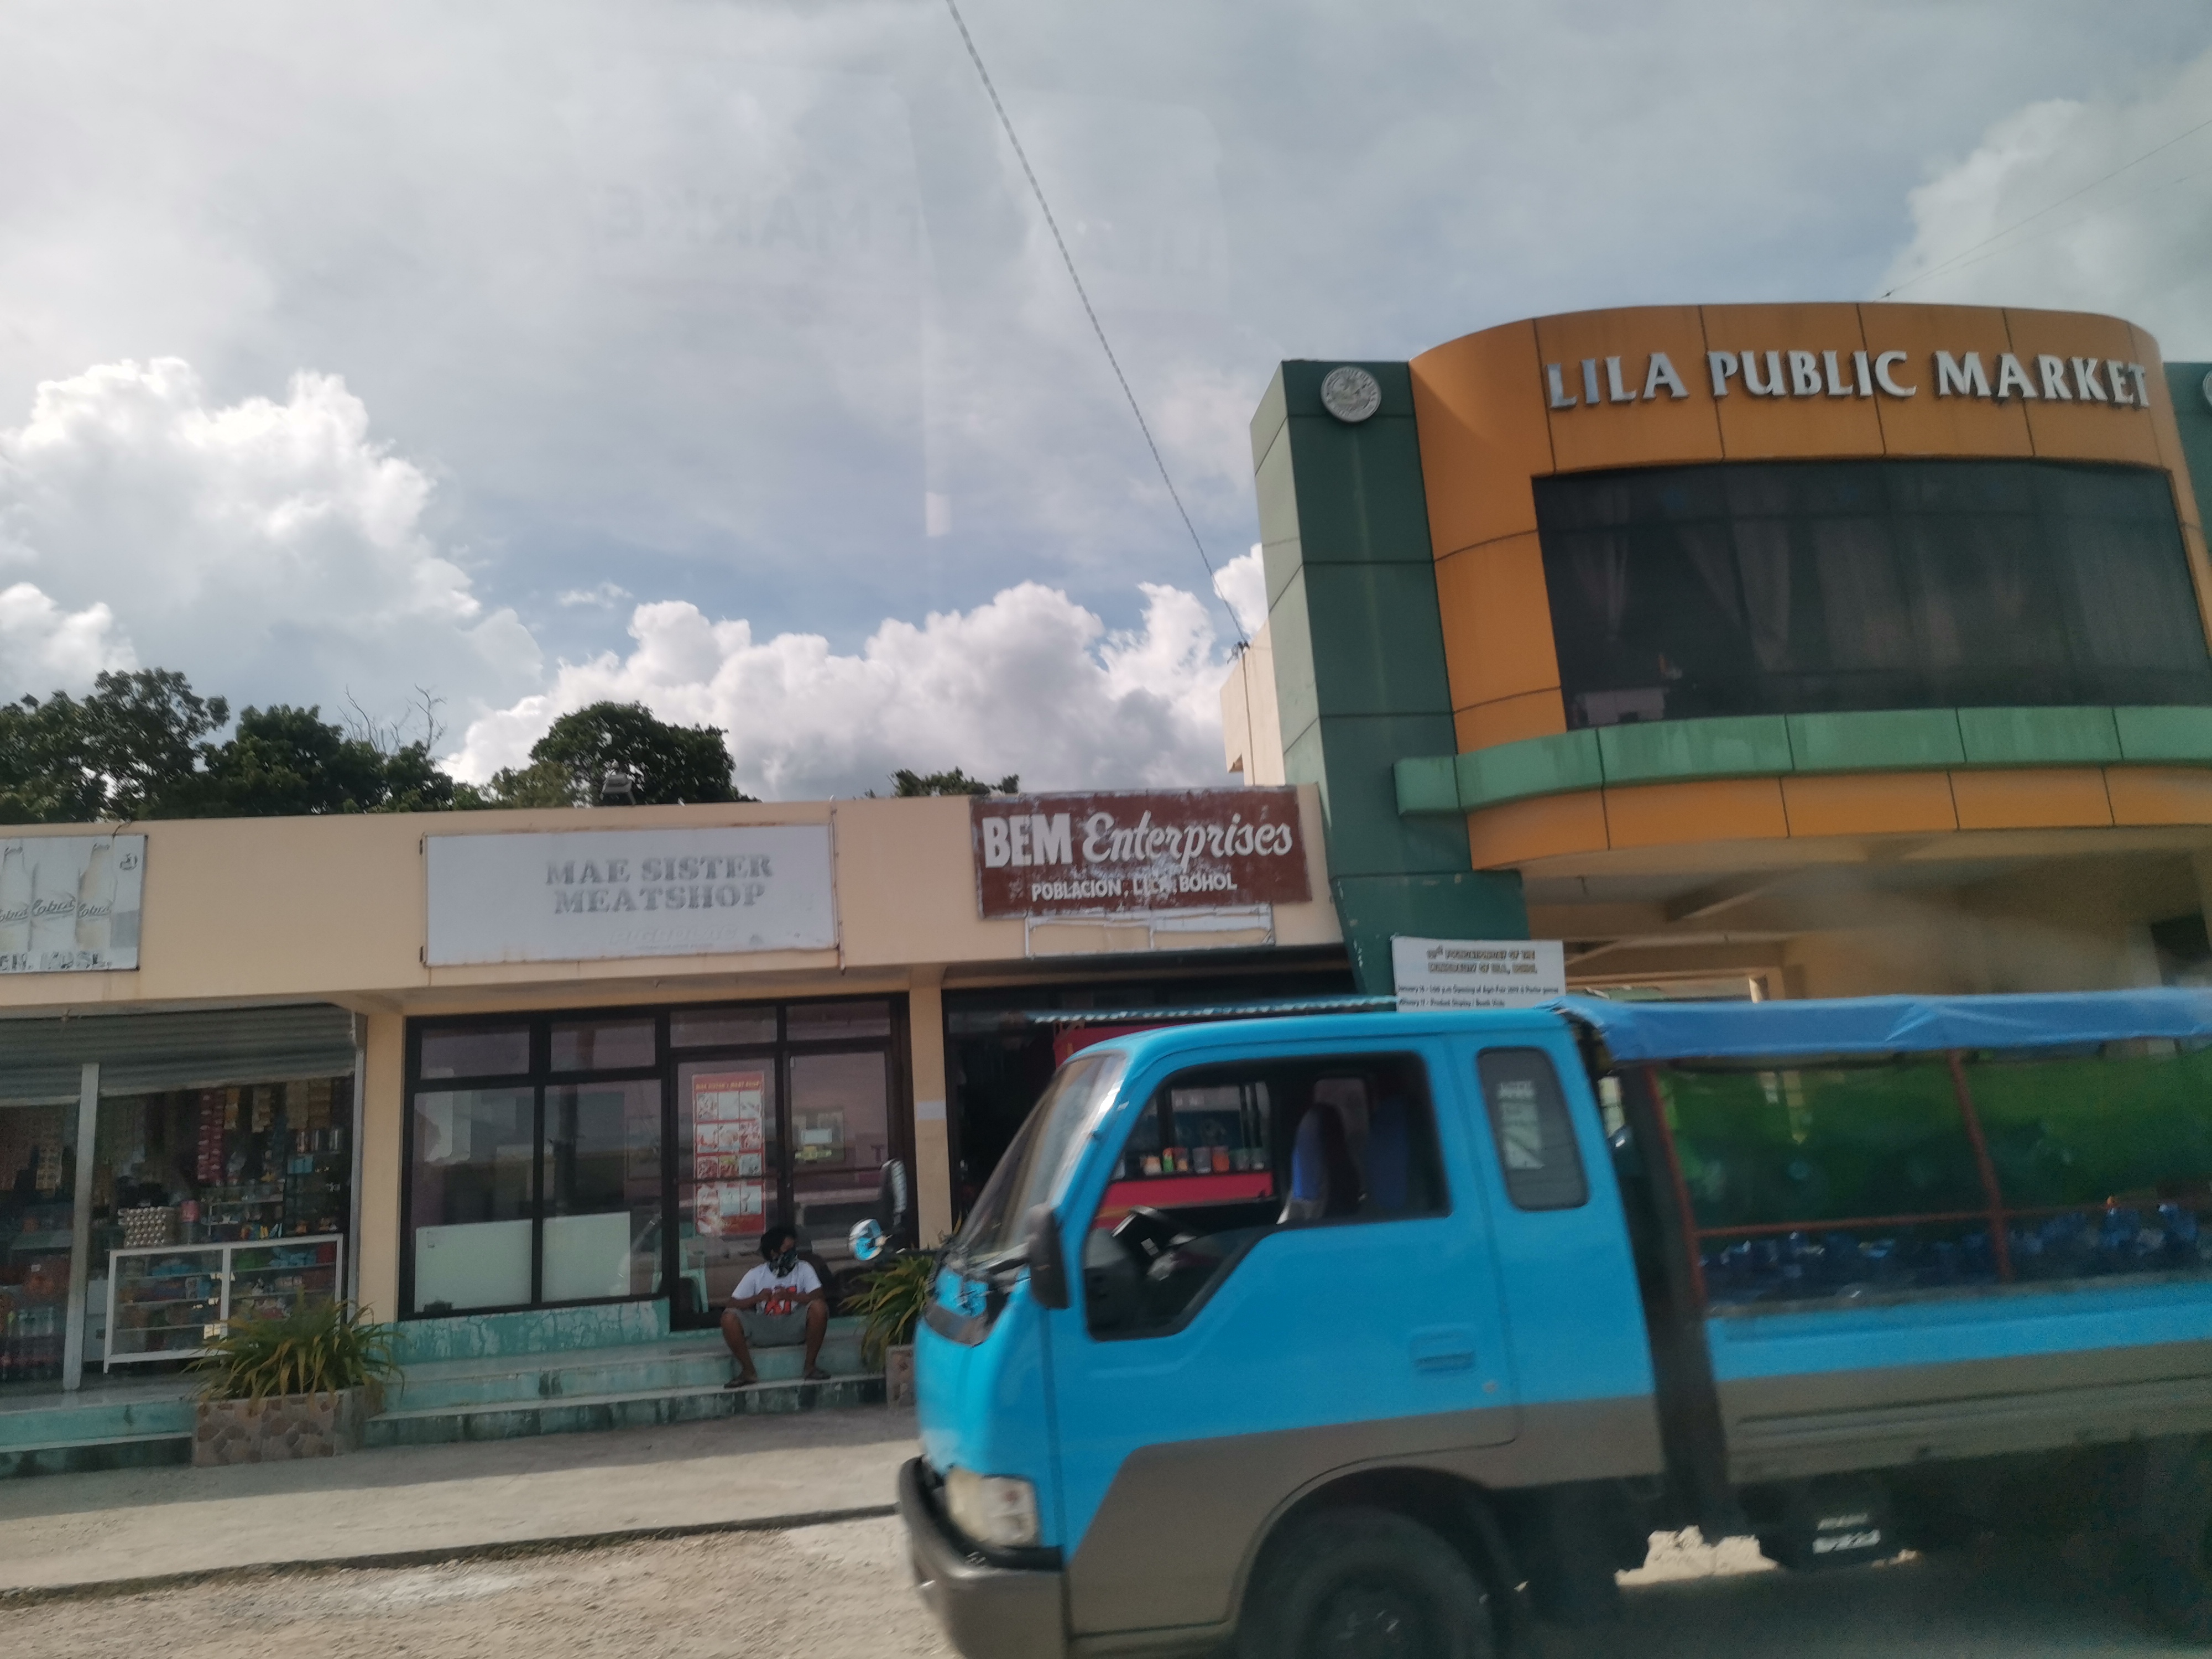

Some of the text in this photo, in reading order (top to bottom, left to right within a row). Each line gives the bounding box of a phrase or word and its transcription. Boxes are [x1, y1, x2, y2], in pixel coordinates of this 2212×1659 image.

[1546, 349, 2150, 408] LILA PUBLIC MARKET
[982, 810, 1293, 873] BEM Enterprises
[545, 854, 773, 885] MAE SISTER
[1178, 871, 1238, 893] BOHOL
[555, 883, 765, 914] MEATSHOP
